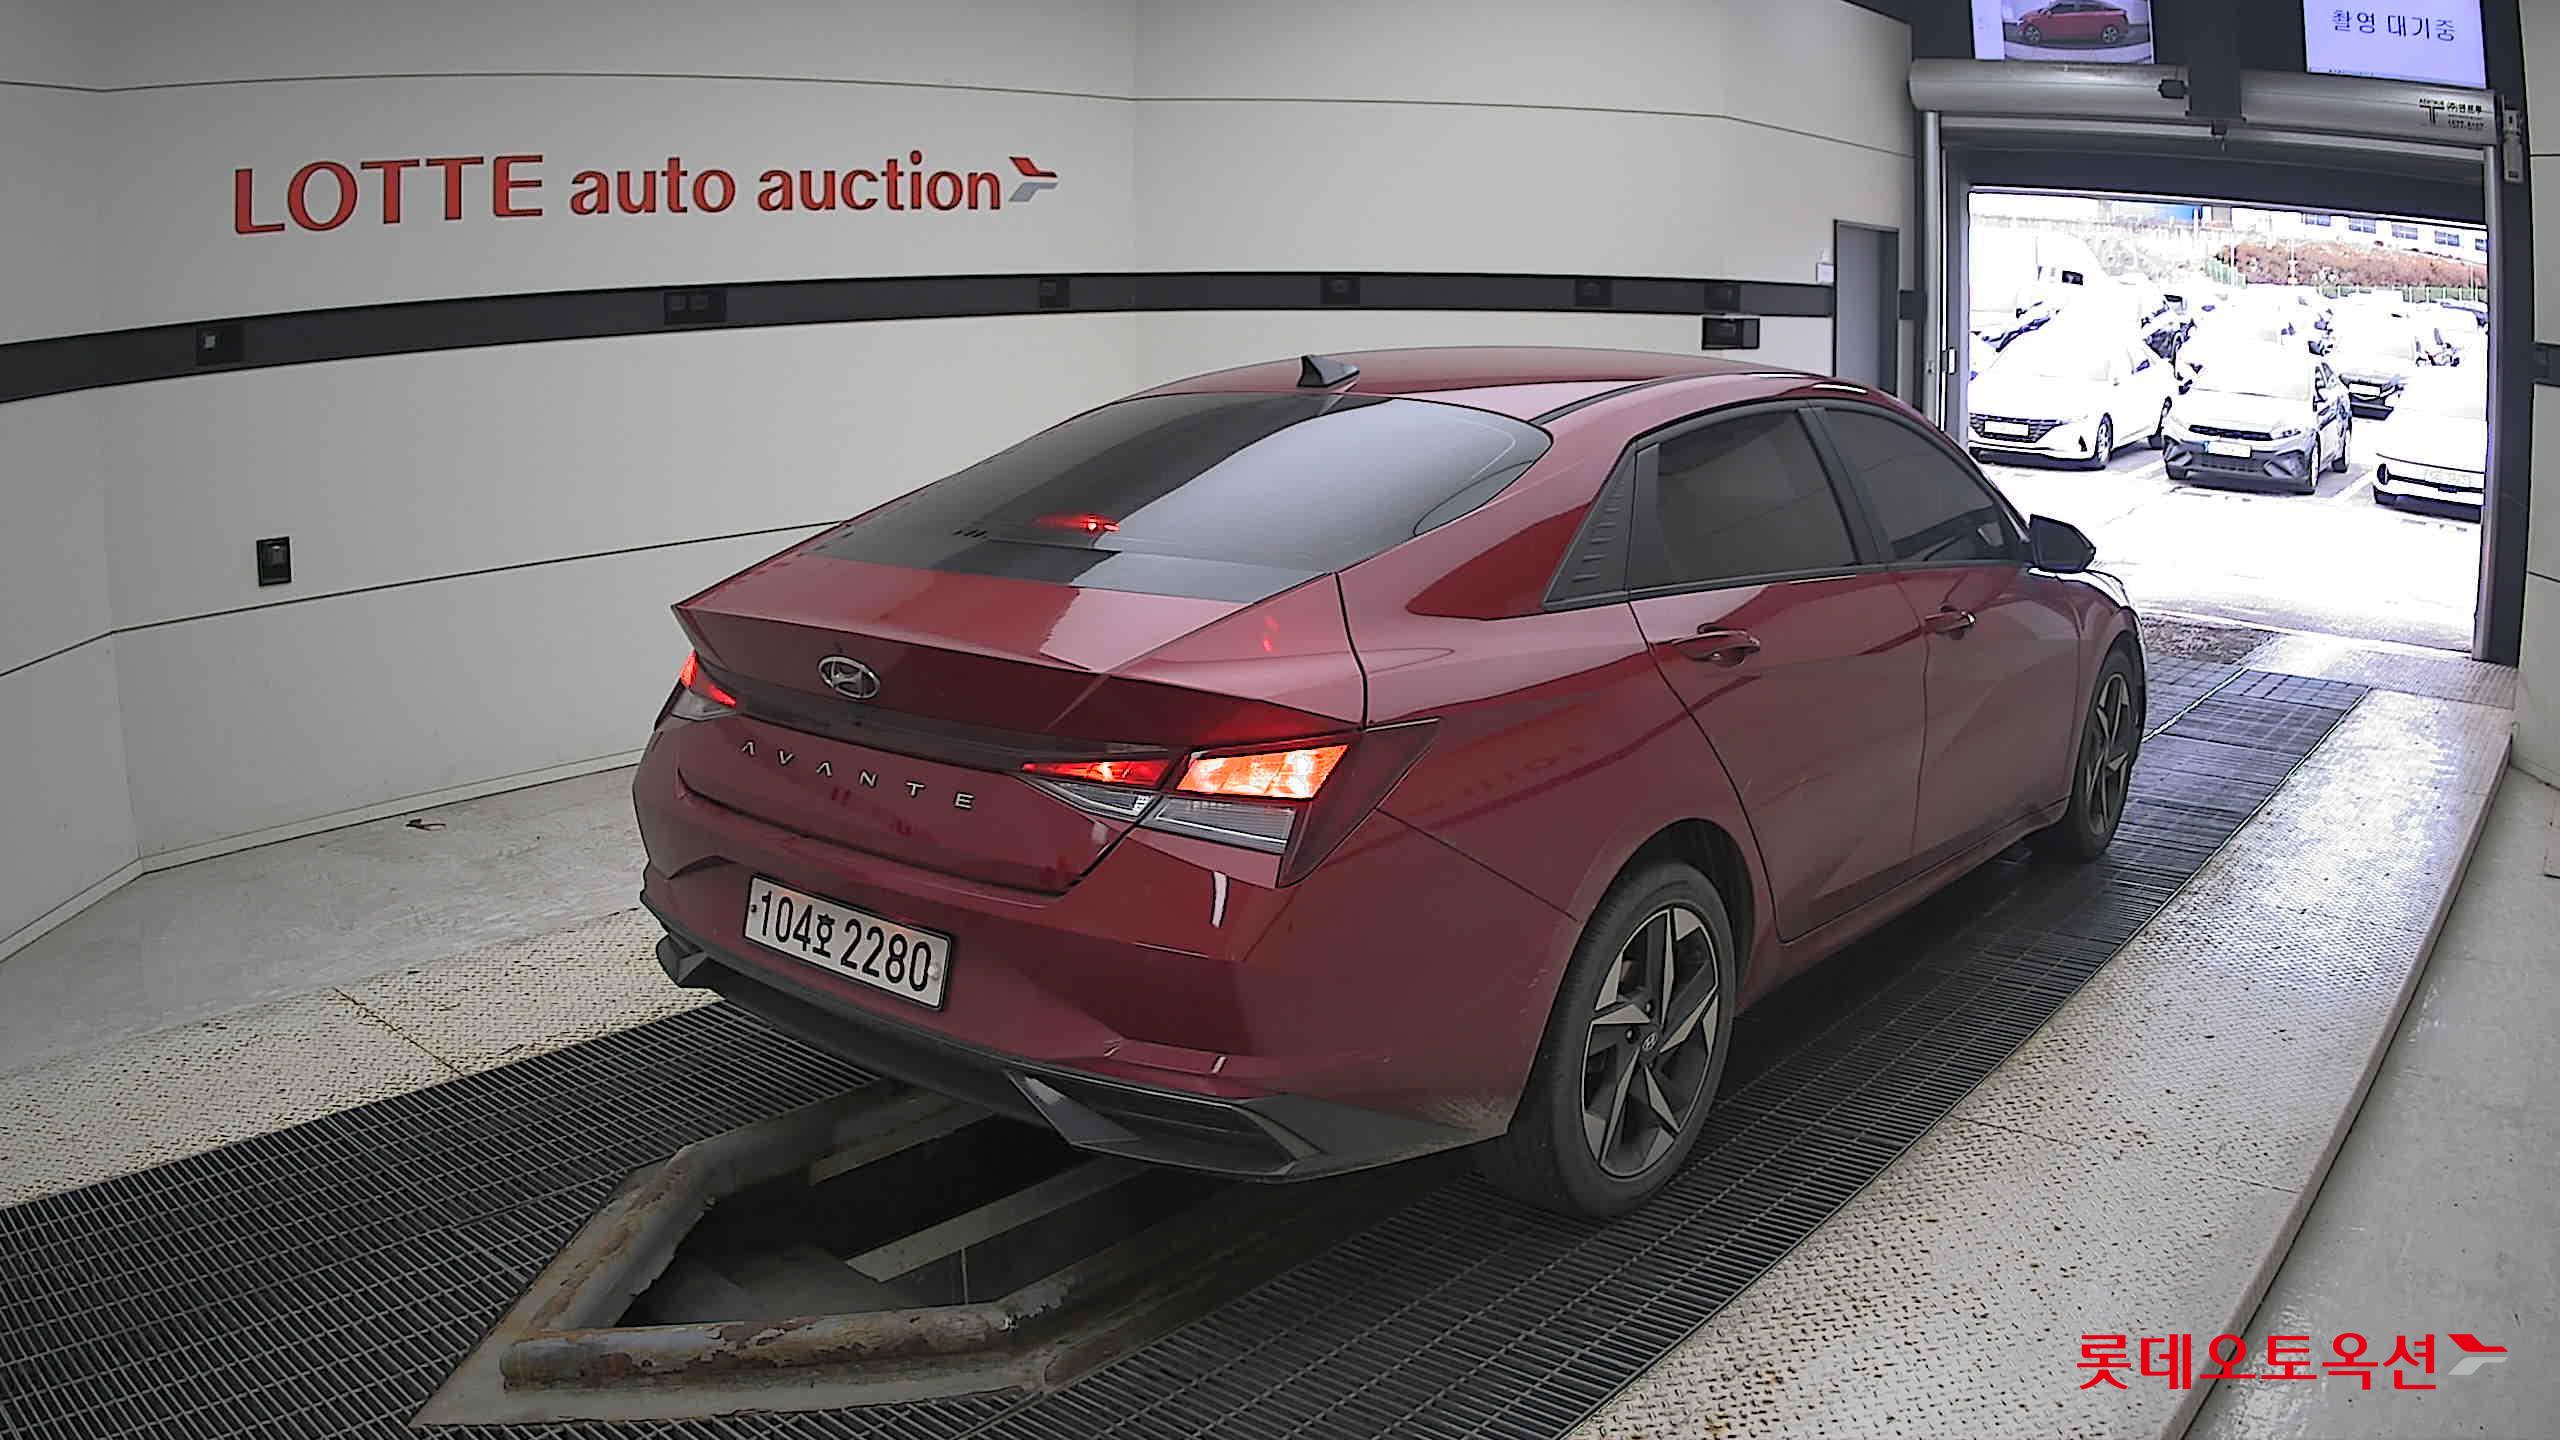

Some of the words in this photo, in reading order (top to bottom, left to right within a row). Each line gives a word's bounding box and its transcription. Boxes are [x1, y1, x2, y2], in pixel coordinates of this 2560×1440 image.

[2387, 15, 2456, 42] 대기중
[235, 156, 542, 233] LOTTE
[570, 158, 737, 214] auto
[757, 151, 1002, 210] auction
[741, 741, 975, 809] AVANTE
[840, 918, 932, 992] 2280
